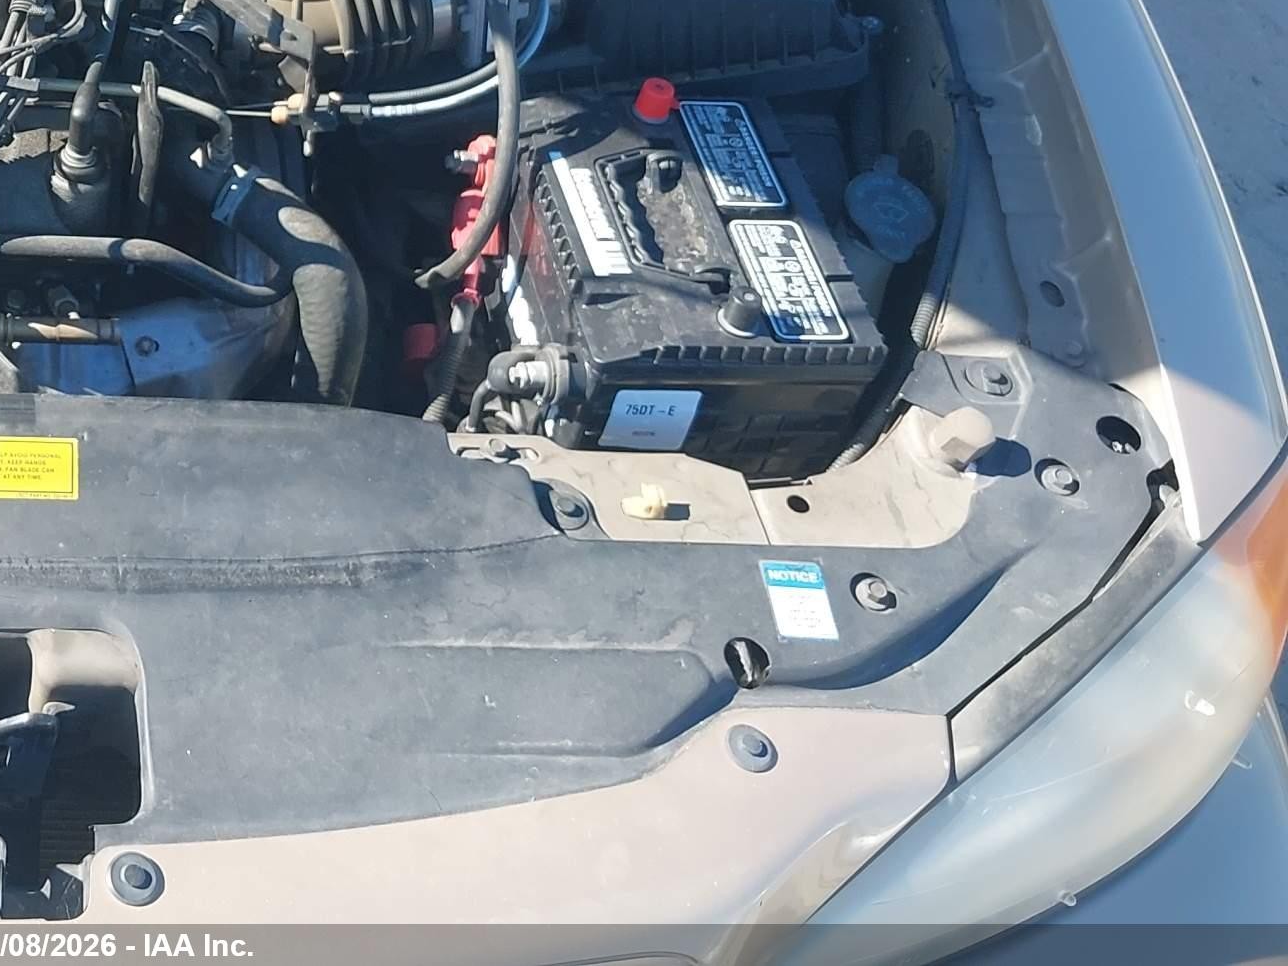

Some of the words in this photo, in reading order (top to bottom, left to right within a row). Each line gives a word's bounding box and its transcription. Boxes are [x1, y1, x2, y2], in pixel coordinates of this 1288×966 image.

[625, 404, 655, 416] 75DT
[668, 406, 676, 416] E
[767, 569, 818, 583] NOTICE
